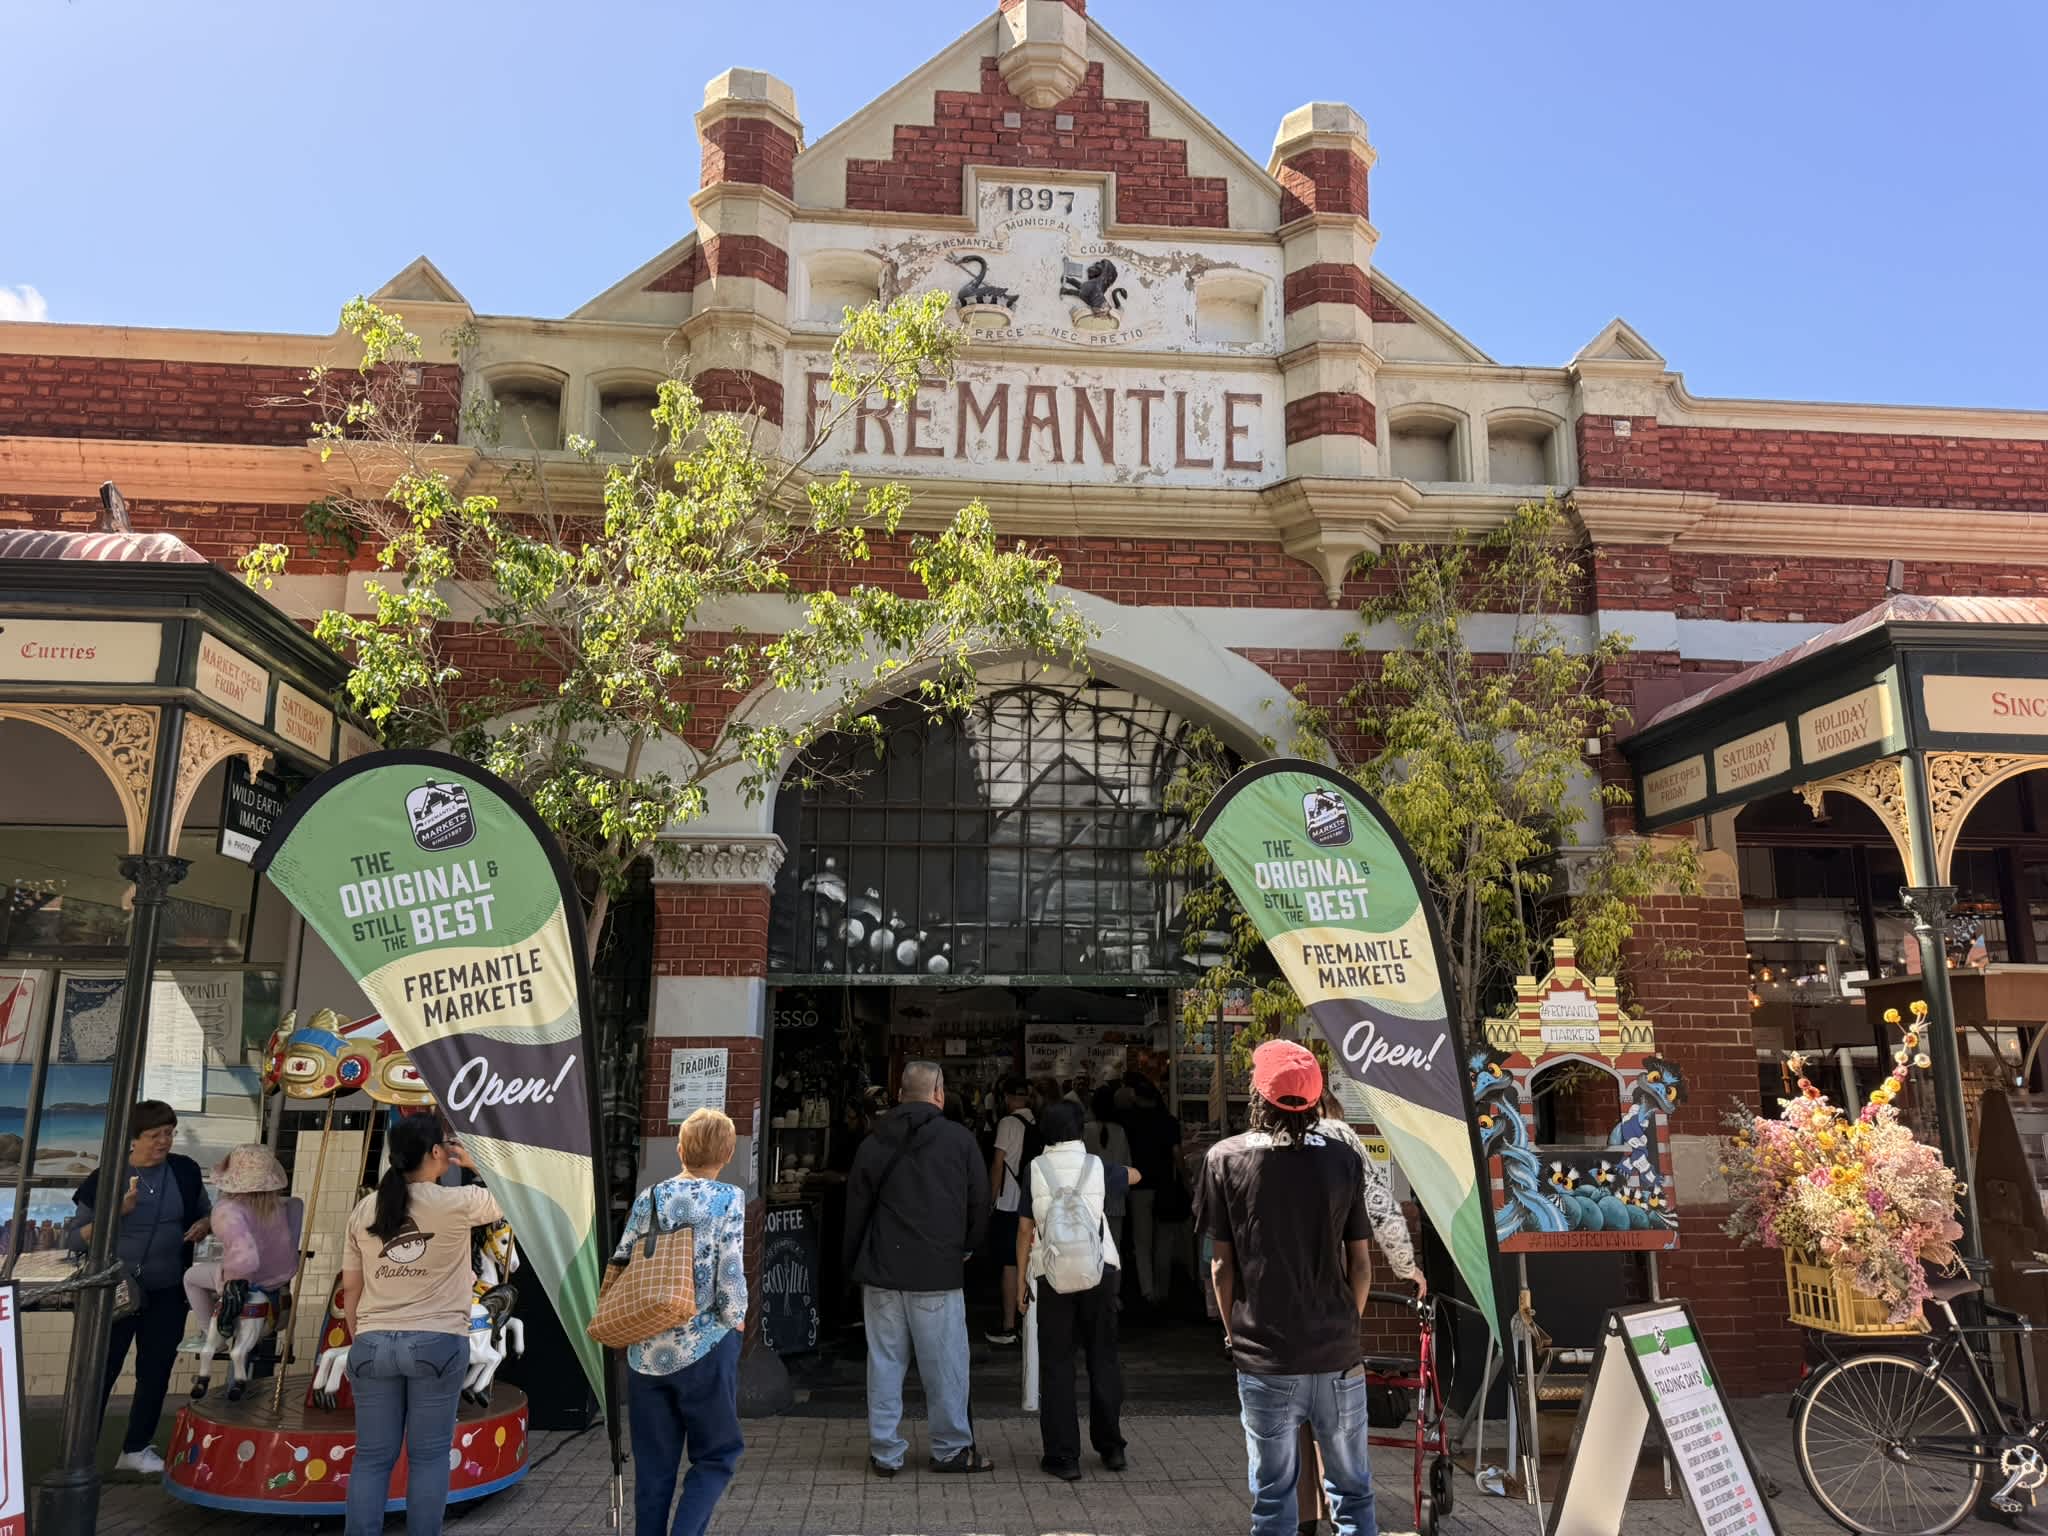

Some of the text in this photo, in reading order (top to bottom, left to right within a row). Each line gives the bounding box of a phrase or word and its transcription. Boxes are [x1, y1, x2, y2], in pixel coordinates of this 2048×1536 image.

[1006, 187, 1075, 214] 1897
[1005, 217, 1071, 234] MUNICIPAL
[935, 237, 1004, 252] FREMANTLE
[975, 327, 1143, 344] PRECE NEC PRETIO
[804, 371, 1264, 473] FREMANTLE
[21, 641, 97, 660] Curries
[202, 645, 263, 694] MARKET OPEN
[214, 674, 247, 702] FRIDAY
[282, 695, 326, 730] SATURDAY
[1813, 697, 1870, 735] HOLIDAY
[285, 719, 320, 749] SUNDAY
[1815, 719, 1871, 755] MONDAY
[1721, 734, 1778, 769] SATURDAY
[1729, 757, 1774, 785] SUNDAY
[232, 783, 283, 817] WILD EARTH
[239, 809, 273, 835] IMAGES
[421, 812, 468, 842] MARKETS
[1311, 817, 1345, 838] MARKETS
[1262, 839, 1294, 858] THE
[351, 850, 395, 878] THE
[1254, 857, 1370, 890] ORIGINAL &
[339, 859, 499, 919] ORIGINAL &
[1263, 887, 1369, 922] STILL BEST
[1284, 909, 1304, 924] THE
[352, 894, 496, 946] STILL BEST
[382, 934, 409, 953] THE
[1302, 938, 1413, 966] FREMANTLE
[403, 948, 544, 1003] FREMANTLE
[1317, 963, 1407, 989] MARKETS
[423, 979, 534, 1028] MARKETS
[1341, 1020, 1447, 1074] Open!
[1550, 1027, 1595, 1042] MARKETS
[680, 1054, 720, 1076] TRADING
[447, 1053, 577, 1123] Open!
[375, 1264, 430, 1280] Malbon
[1654, 1370, 1703, 1396] TRADING DAYS
